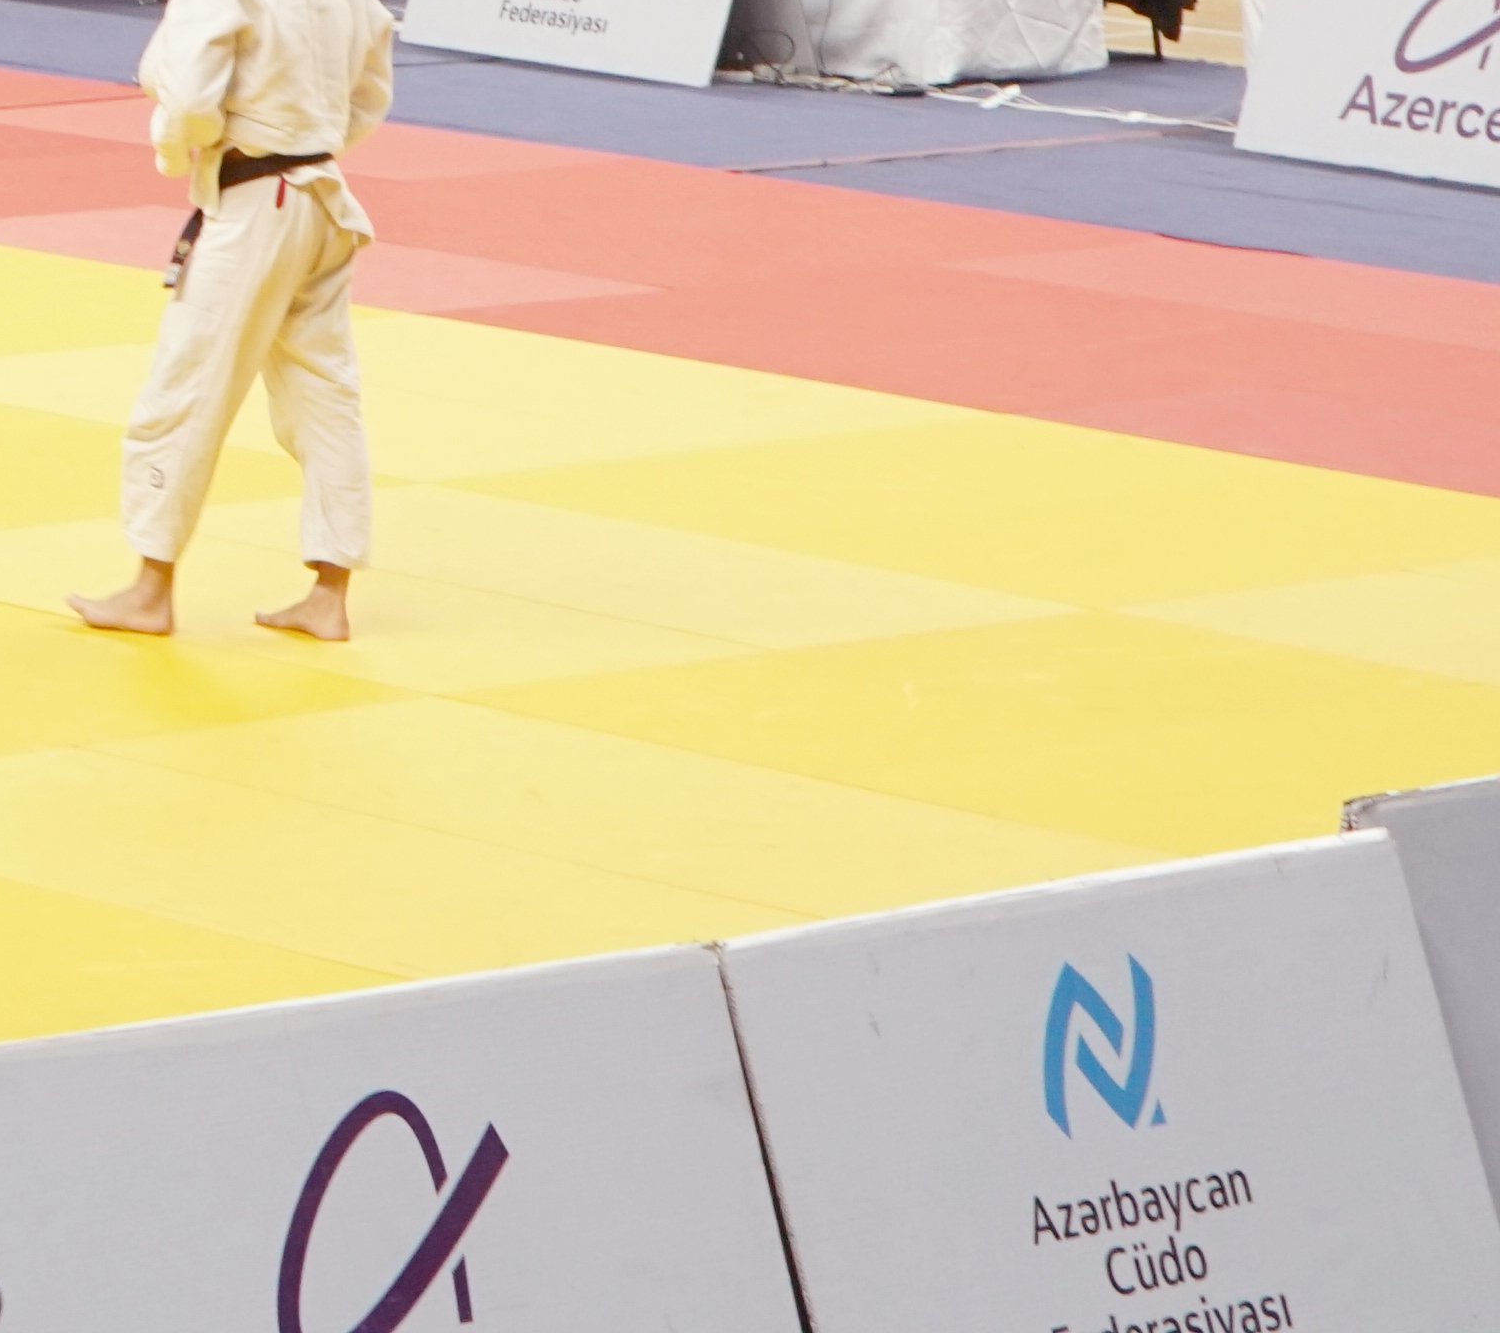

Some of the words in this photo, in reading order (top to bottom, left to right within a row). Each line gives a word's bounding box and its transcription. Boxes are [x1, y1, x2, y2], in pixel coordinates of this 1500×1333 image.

[499, 0, 608, 33] Federasiyası
[1339, 74, 1500, 142] Azerce
[1033, 1168, 1253, 1246] Azərbaycan
[1106, 1235, 1208, 1296] Cüdo
